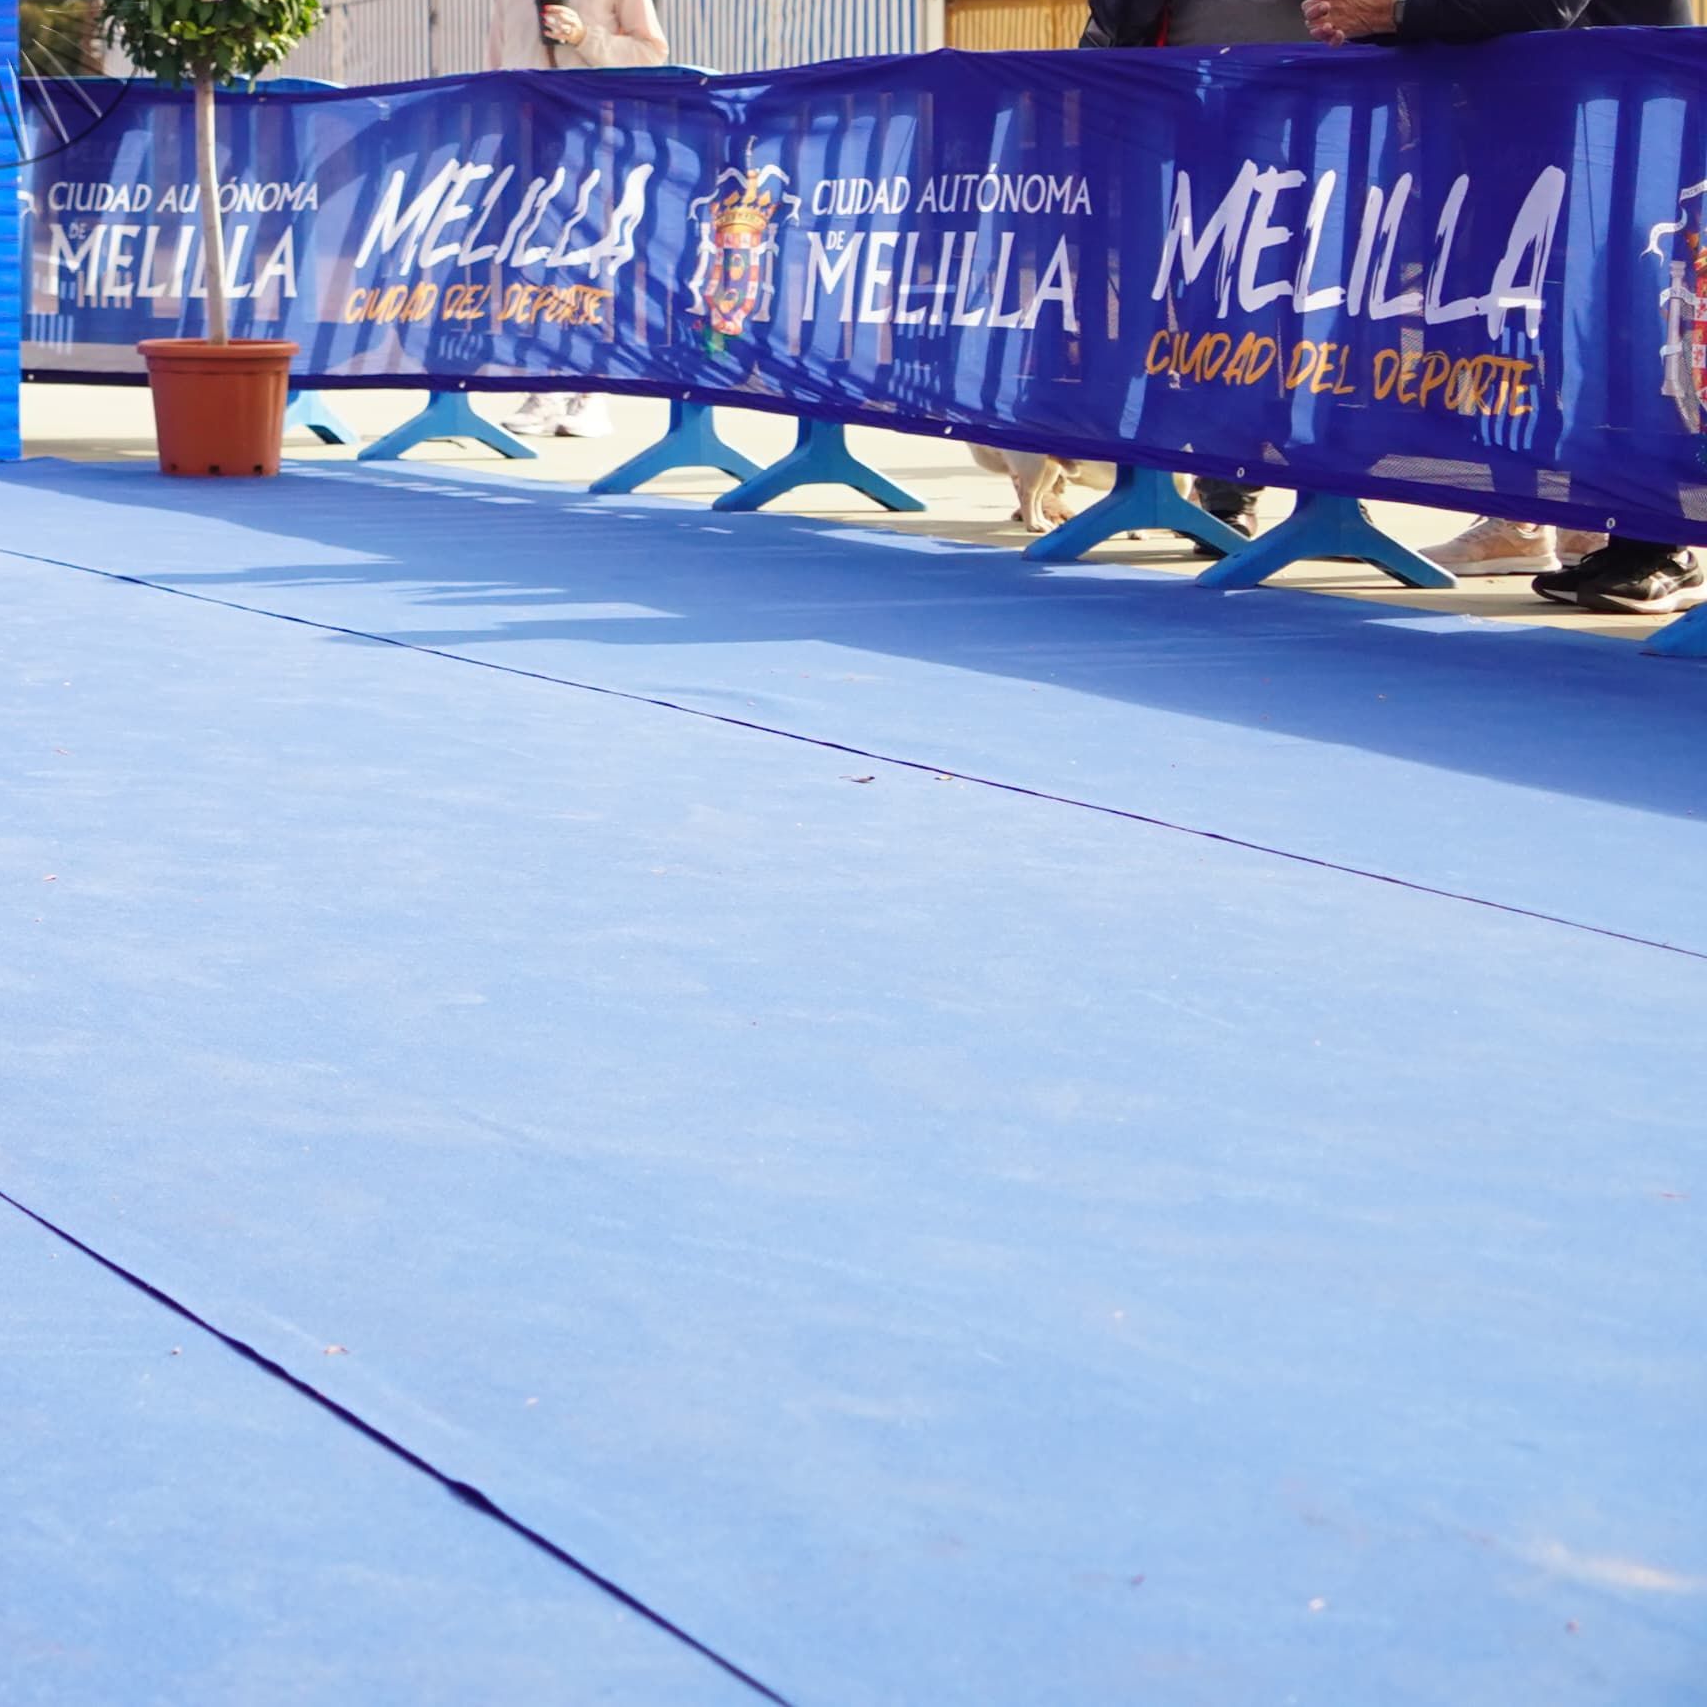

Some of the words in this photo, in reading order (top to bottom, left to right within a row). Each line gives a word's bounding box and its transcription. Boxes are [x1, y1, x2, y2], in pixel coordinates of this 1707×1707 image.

[48, 181, 153, 213] CIUDAD
[155, 175, 319, 214] AUÓNOMA
[811, 176, 911, 216] CIUDAD
[916, 163, 1093, 216] AUTÓNOMA
[68, 221, 87, 240] DE
[354, 157, 655, 279] MELILLA
[825, 229, 844, 251] DE
[1150, 158, 1566, 339] MELILLA
[344, 284, 430, 326] CIUDAD
[440, 284, 491, 322] DEL
[496, 282, 613, 327] DEPORTE
[802, 231, 1080, 333] MELILLA
[1145, 329, 1277, 388] CIUDAD
[1286, 340, 1355, 395] DEL
[1372, 348, 1535, 417] DEPORTE
